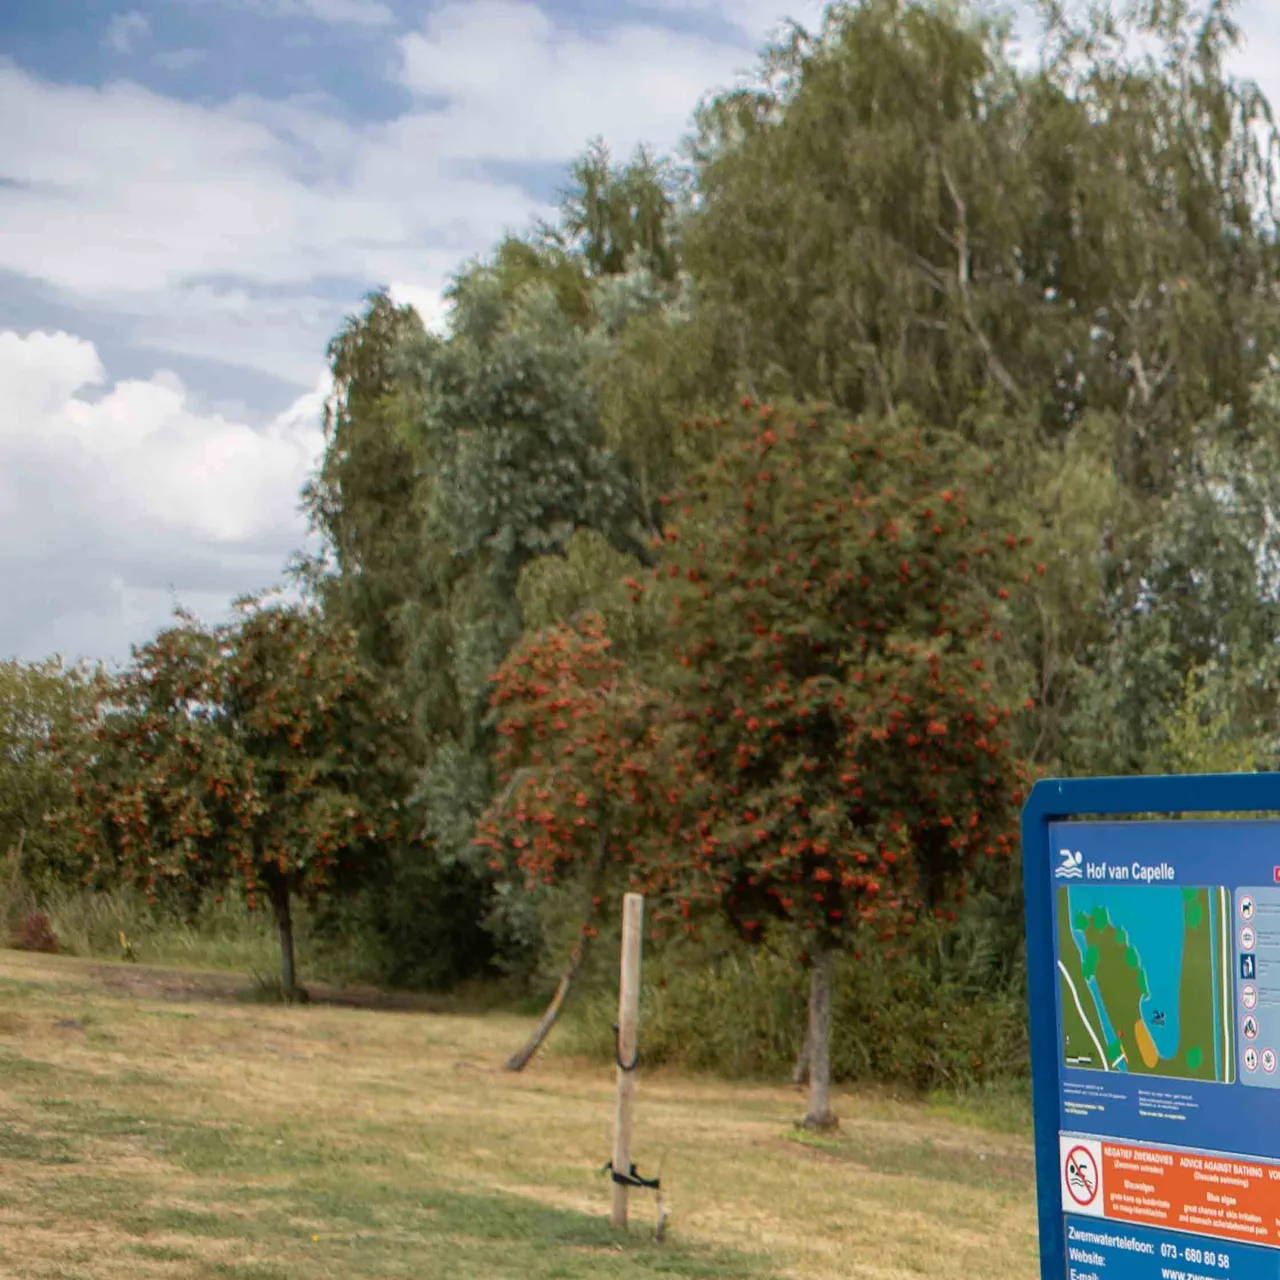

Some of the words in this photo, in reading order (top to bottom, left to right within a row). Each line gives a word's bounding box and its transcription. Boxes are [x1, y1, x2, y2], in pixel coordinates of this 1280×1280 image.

[1086, 862, 1107, 880] Hof
[1108, 867, 1129, 880] van
[1132, 862, 1175, 883] Capelle
[1104, 1146, 1133, 1160] NEGATIEF
[1133, 1150, 1174, 1166] ZWEMADVIES
[1180, 1157, 1203, 1170] ADVICE
[1203, 1160, 1232, 1174] AGAINST
[1233, 1164, 1264, 1179] BATHING
[1206, 1191, 1220, 1203] Blue
[1198, 1205, 1218, 1217] chance
[1218, 1208, 1225, 1217] of
[1225, 1210, 1238, 1219] skin
[1179, 1214, 1189, 1223] and
[1255, 1226, 1269, 1236] pain
[1068, 1226, 1155, 1255] Zwemwatertelefoon:
[1160, 1243, 1178, 1259] 073
[1185, 1247, 1202, 1264] 680
[1203, 1252, 1216, 1267] 80
[1217, 1254, 1230, 1269] 58
[1069, 1247, 1106, 1267] Website:
